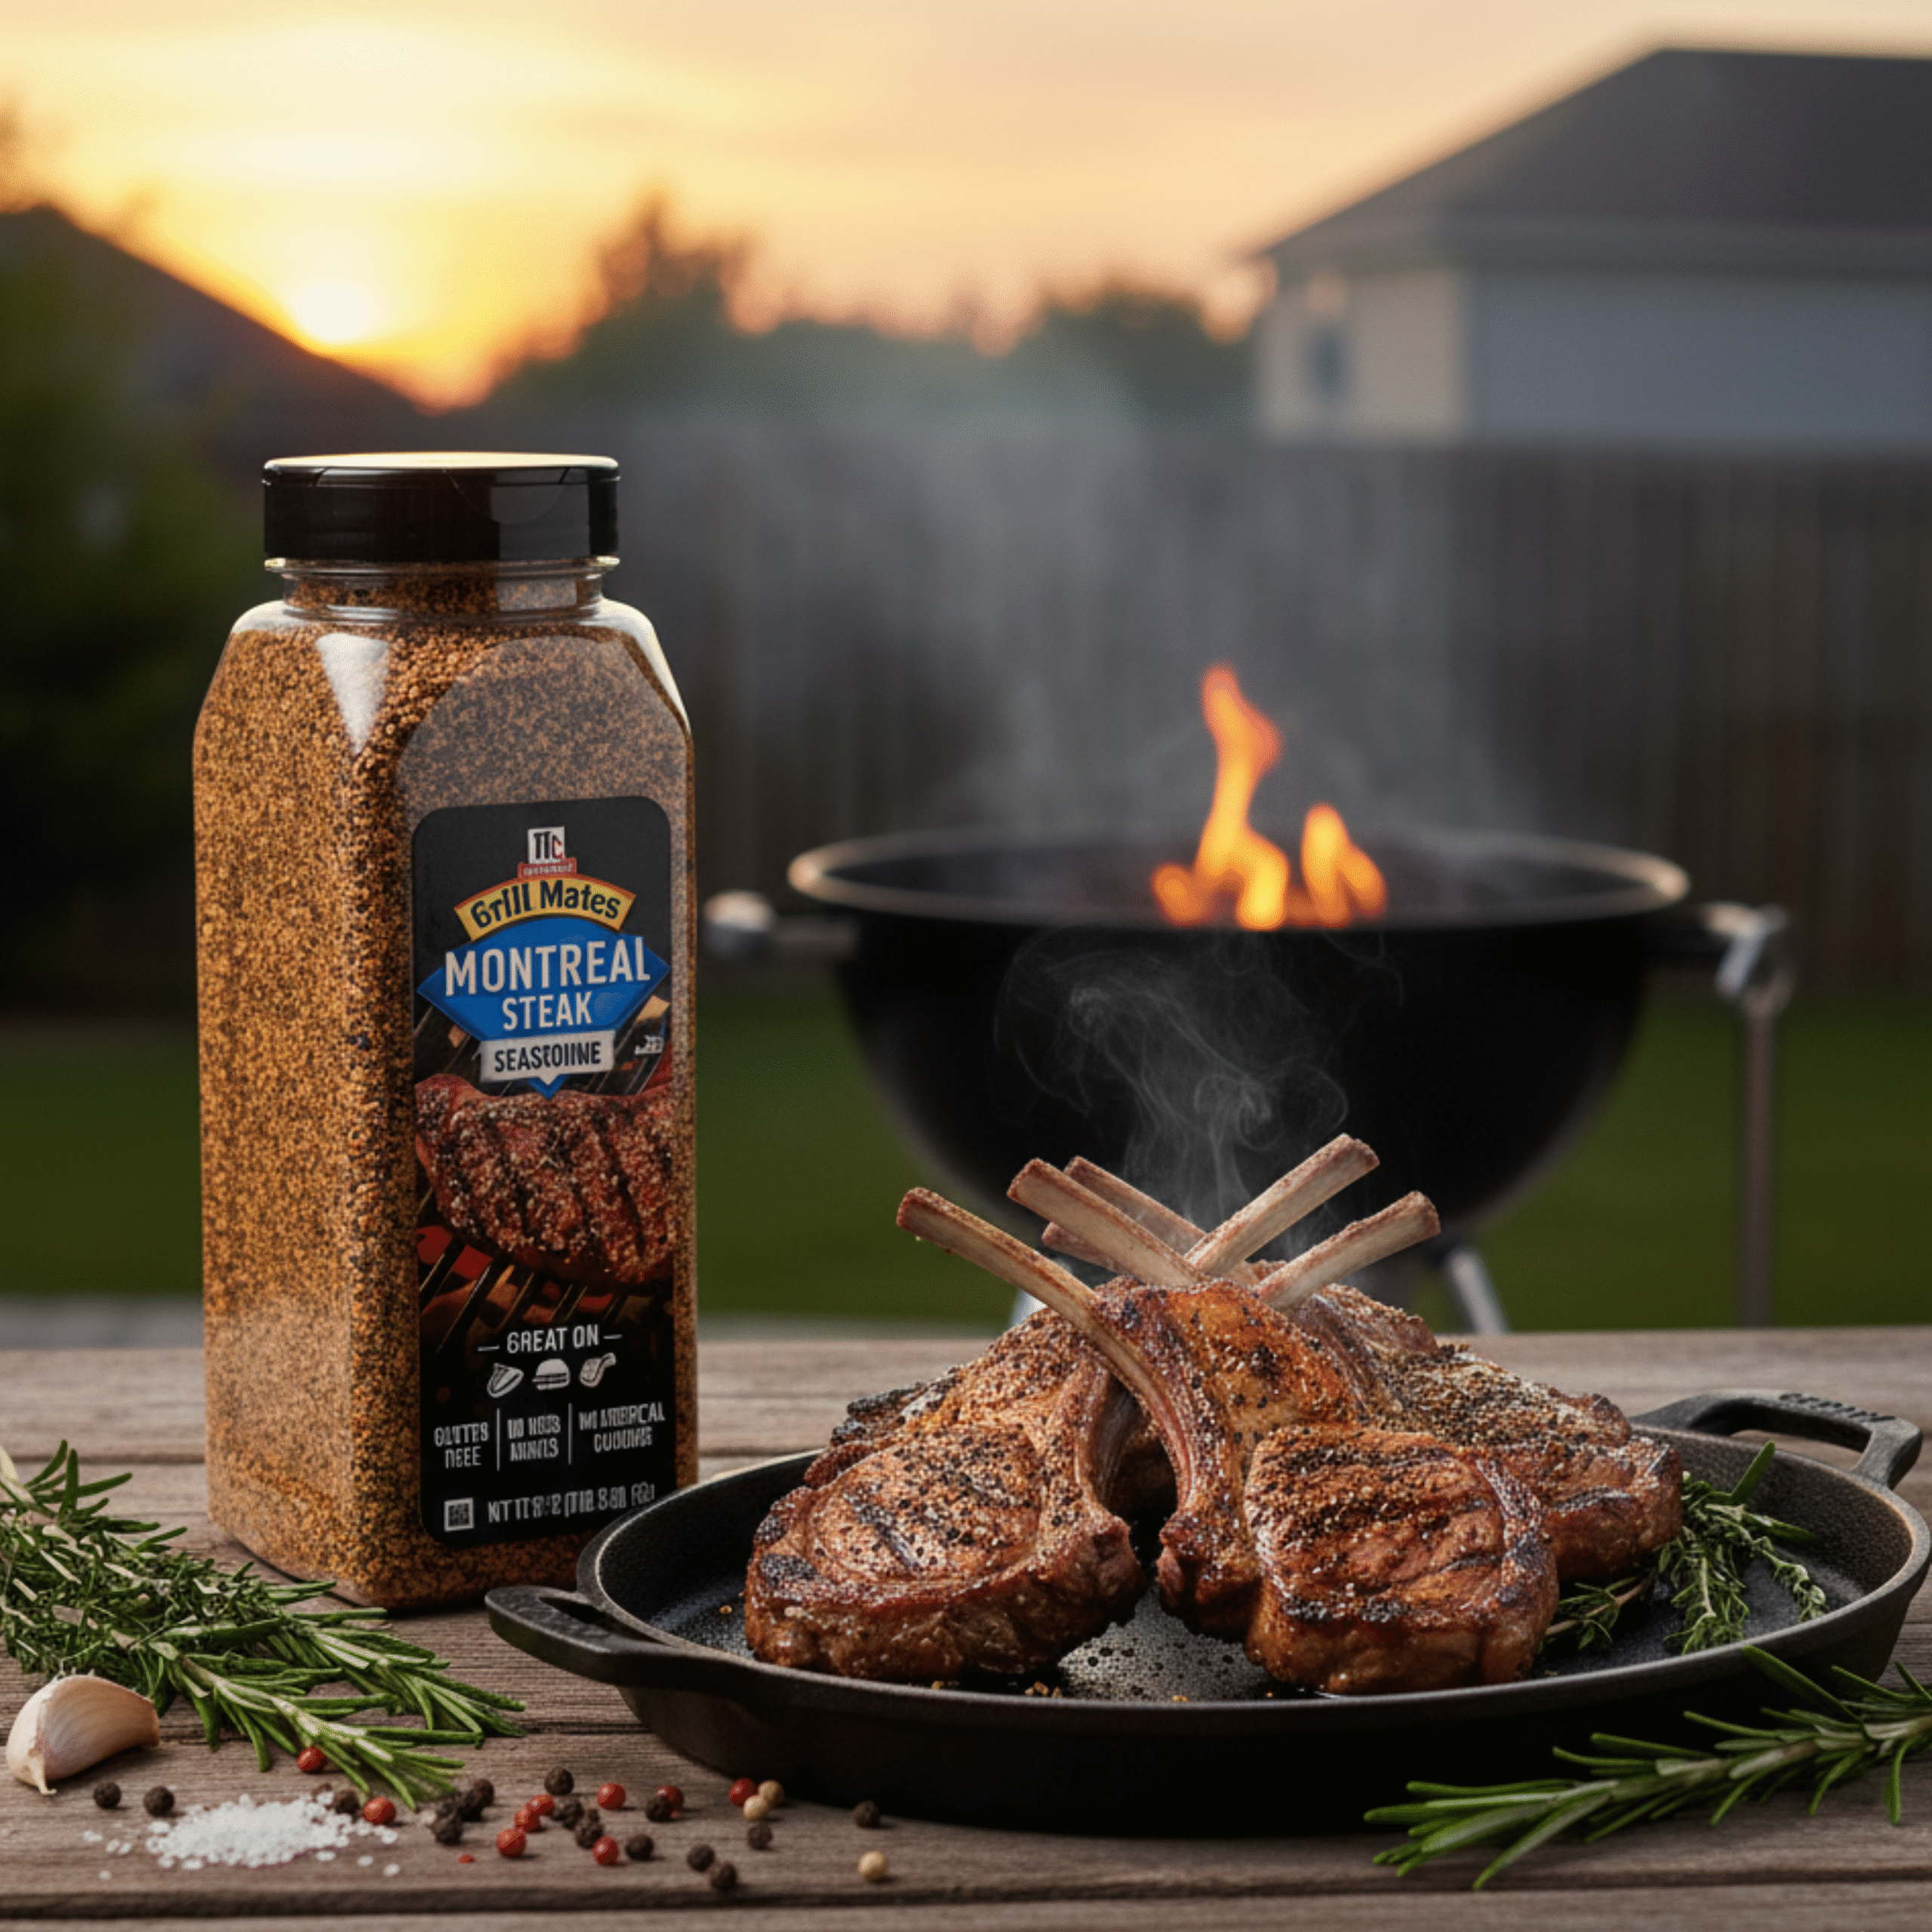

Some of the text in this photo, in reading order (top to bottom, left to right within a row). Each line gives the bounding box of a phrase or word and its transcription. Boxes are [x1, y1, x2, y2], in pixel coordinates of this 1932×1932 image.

[540, 879, 621, 920] Mates
[445, 937, 651, 997] MONTREAL
[502, 991, 592, 1031] STEAK
[572, 1324, 599, 1349] ON
